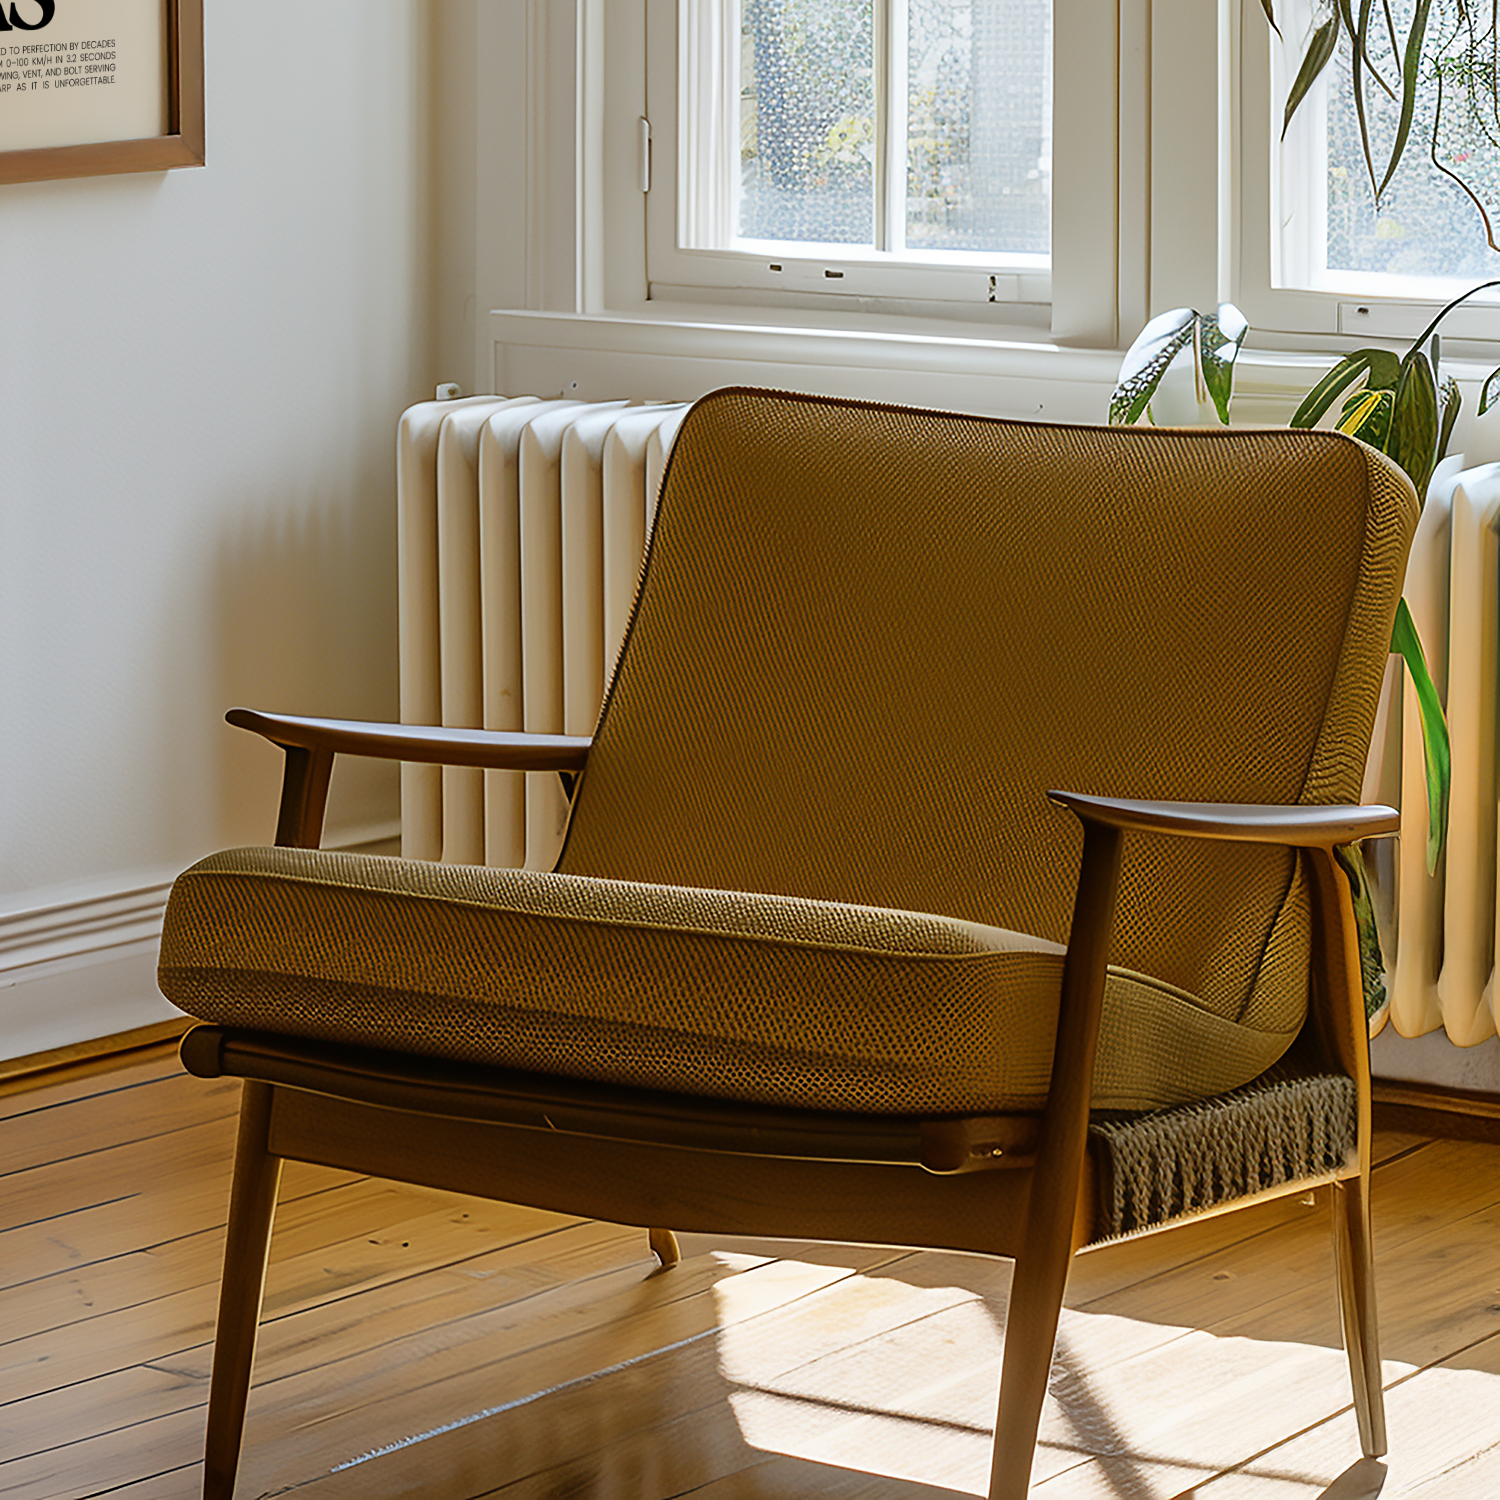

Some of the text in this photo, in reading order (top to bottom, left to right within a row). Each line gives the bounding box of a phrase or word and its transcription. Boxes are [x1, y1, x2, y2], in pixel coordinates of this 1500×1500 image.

[9, 46, 20, 55] TO
[22, 42, 67, 55] PERFECTION
[69, 41, 79, 51] BY
[81, 39, 115, 50] DECADES
[32, 55, 52, 67] KM/H
[55, 55, 63, 64] IN
[80, 51, 116, 62] SECONDS
[22, 69, 43, 79] VENT,
[45, 67, 62, 77] AND
[64, 66, 82, 76] BOLT
[84, 63, 116, 74] SERVING
[16, 82, 26, 92] AS
[31, 81, 37, 91] IT
[43, 80, 49, 90] IS
